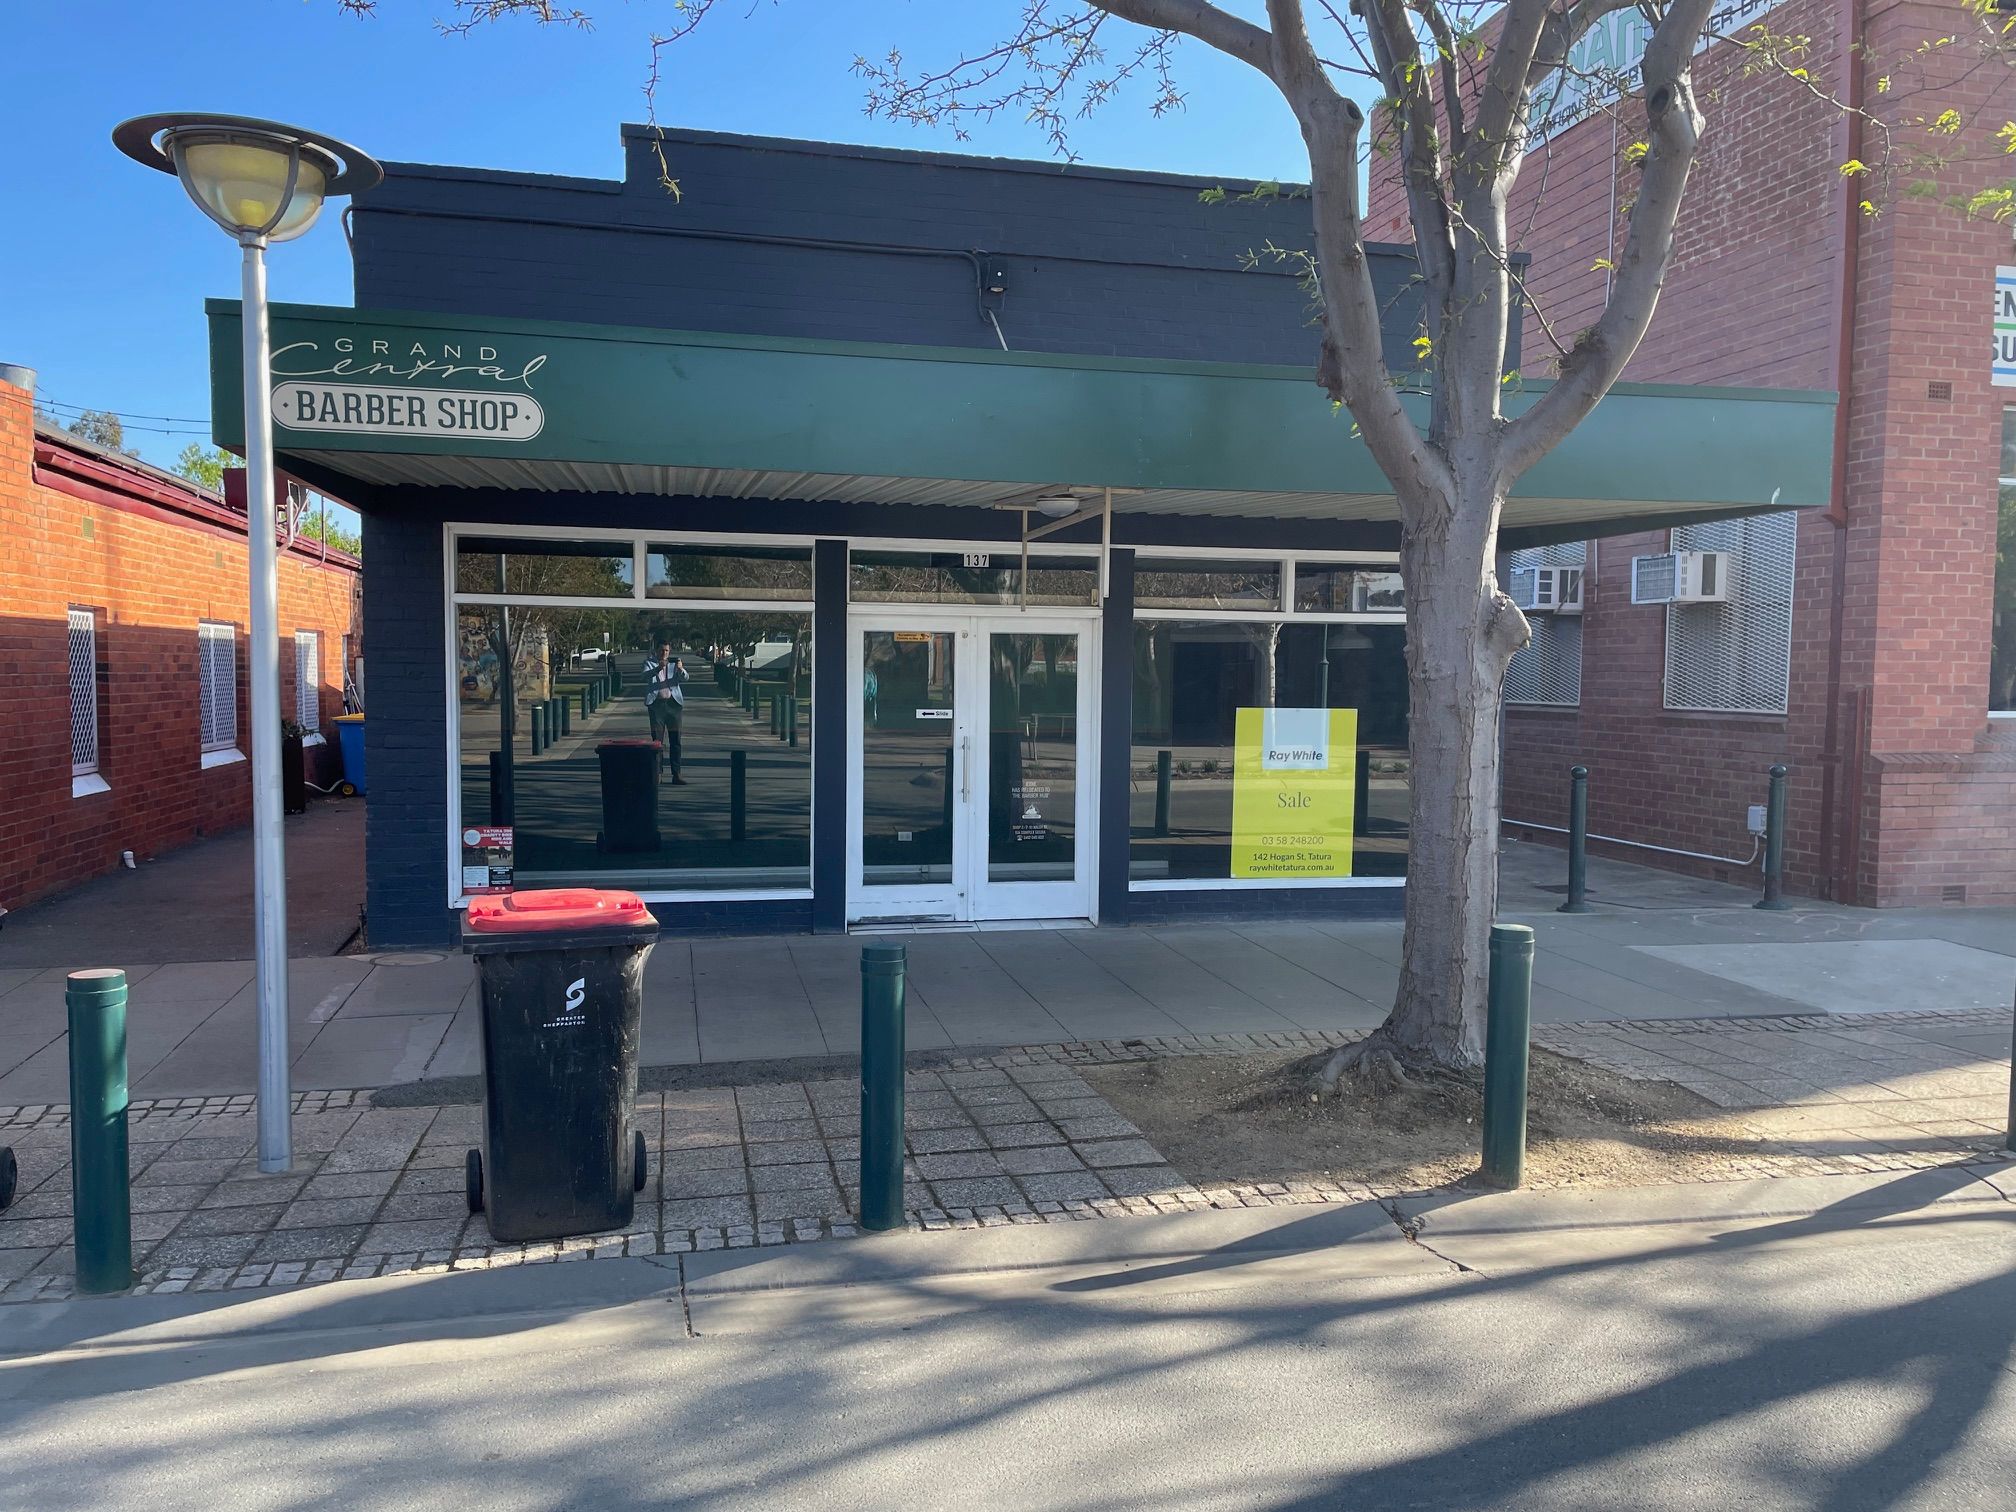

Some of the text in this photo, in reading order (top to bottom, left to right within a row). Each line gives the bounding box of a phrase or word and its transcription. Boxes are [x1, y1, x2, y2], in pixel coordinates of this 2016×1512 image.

[334, 337, 498, 361] GRAND
[270, 341, 548, 390] Central
[295, 389, 519, 432] BARBER SHOP
[966, 554, 988, 567] 137
[1268, 750, 1323, 762] Ray White
[1277, 791, 1312, 809] Sale
[1261, 836, 1324, 846] 03 58 248200
[1253, 853, 1268, 861] 142
[1269, 852, 1295, 862] Hogan
[1307, 852, 1332, 861] Tatura
[1249, 863, 1335, 872] raywhitetatura.com.au
